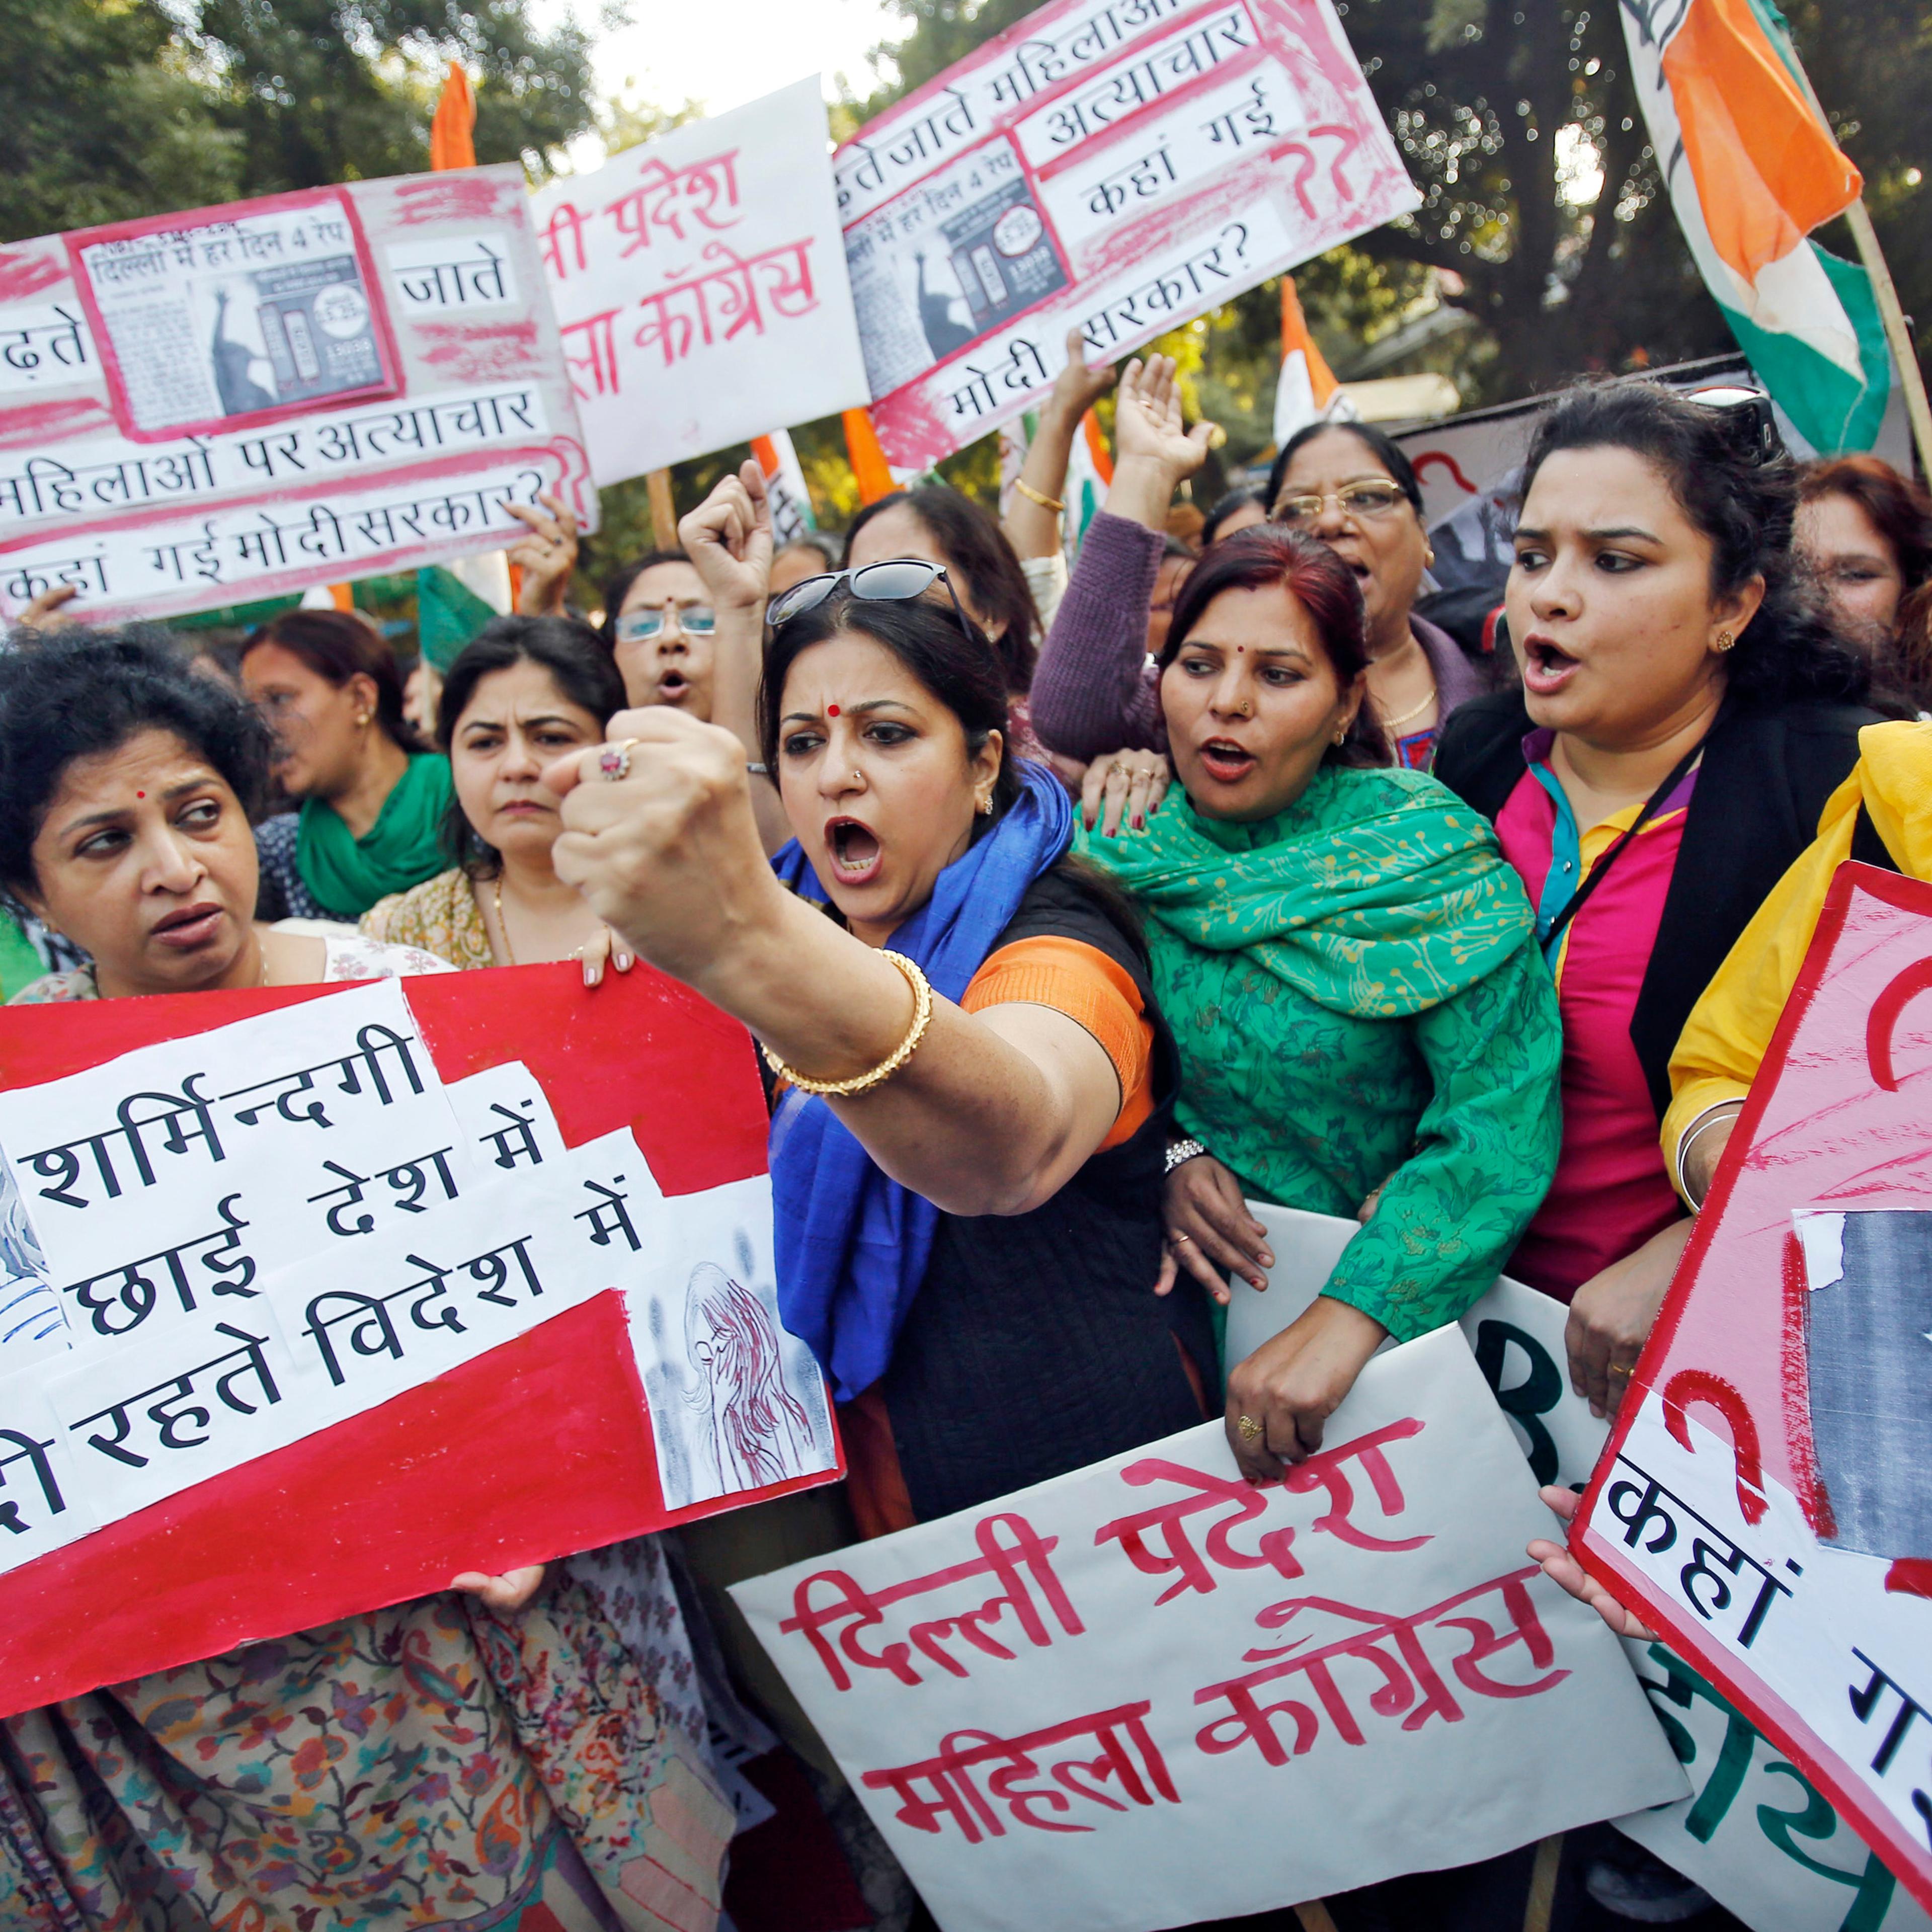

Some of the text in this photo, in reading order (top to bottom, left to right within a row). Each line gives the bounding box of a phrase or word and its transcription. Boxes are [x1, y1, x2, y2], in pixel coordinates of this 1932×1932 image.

[885, 87, 975, 164] जाते
[1047, 9, 1250, 143] अत्याचार
[1080, 134, 1176, 214] कहां
[1198, 76, 1278, 146] गई
[291, 226, 307, 250] 4
[392, 240, 505, 303] जाते
[604, 148, 746, 258] प्रदेश
[944, 221, 1253, 417] मोदी सरकार?
[235, 428, 305, 477] पर
[316, 390, 534, 459] अत्याचार
[142, 520, 224, 584] गई
[229, 503, 346, 567] मोदी
[18, 1023, 425, 1209] शर्मिन्दगी
[63, 1099, 543, 1335] छाई देश में
[69, 1322, 282, 1468] रहते
[301, 1235, 543, 1386] विदेश
[574, 1175, 642, 1251] में
[779, 1416, 1436, 1692] दिल्ली प्रदेश
[1607, 1452, 1932, 1857] कहां ग
[861, 1699, 1181, 1844] महिला
